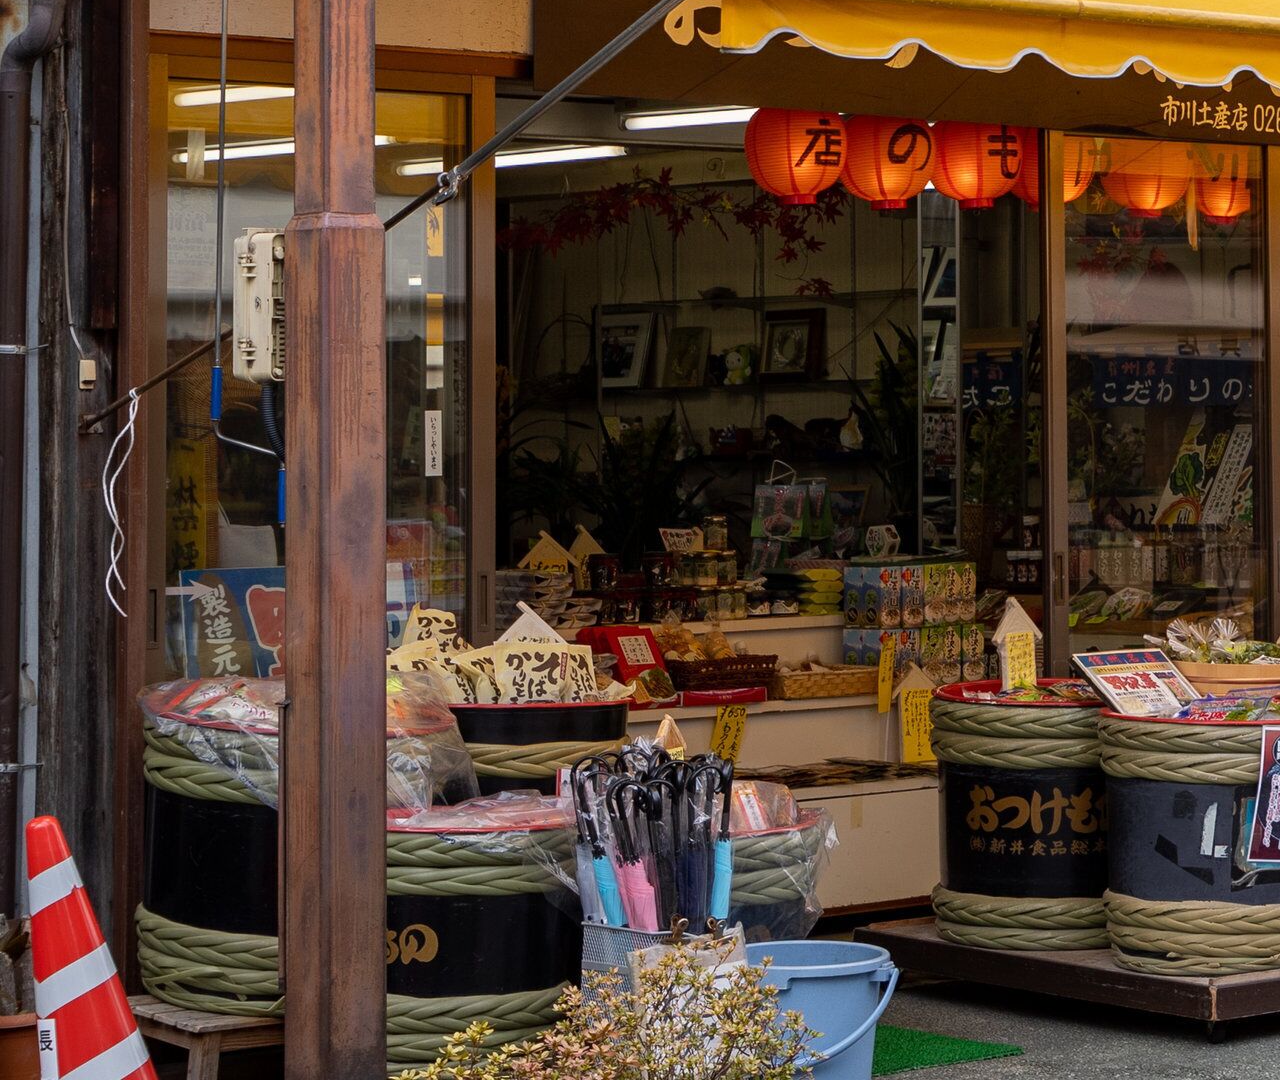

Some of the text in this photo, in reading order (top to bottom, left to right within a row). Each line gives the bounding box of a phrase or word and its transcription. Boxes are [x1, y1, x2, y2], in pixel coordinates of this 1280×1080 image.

[1160, 95, 1249, 131] 市川土産店
[720, 705, 746, 722] ¥650
